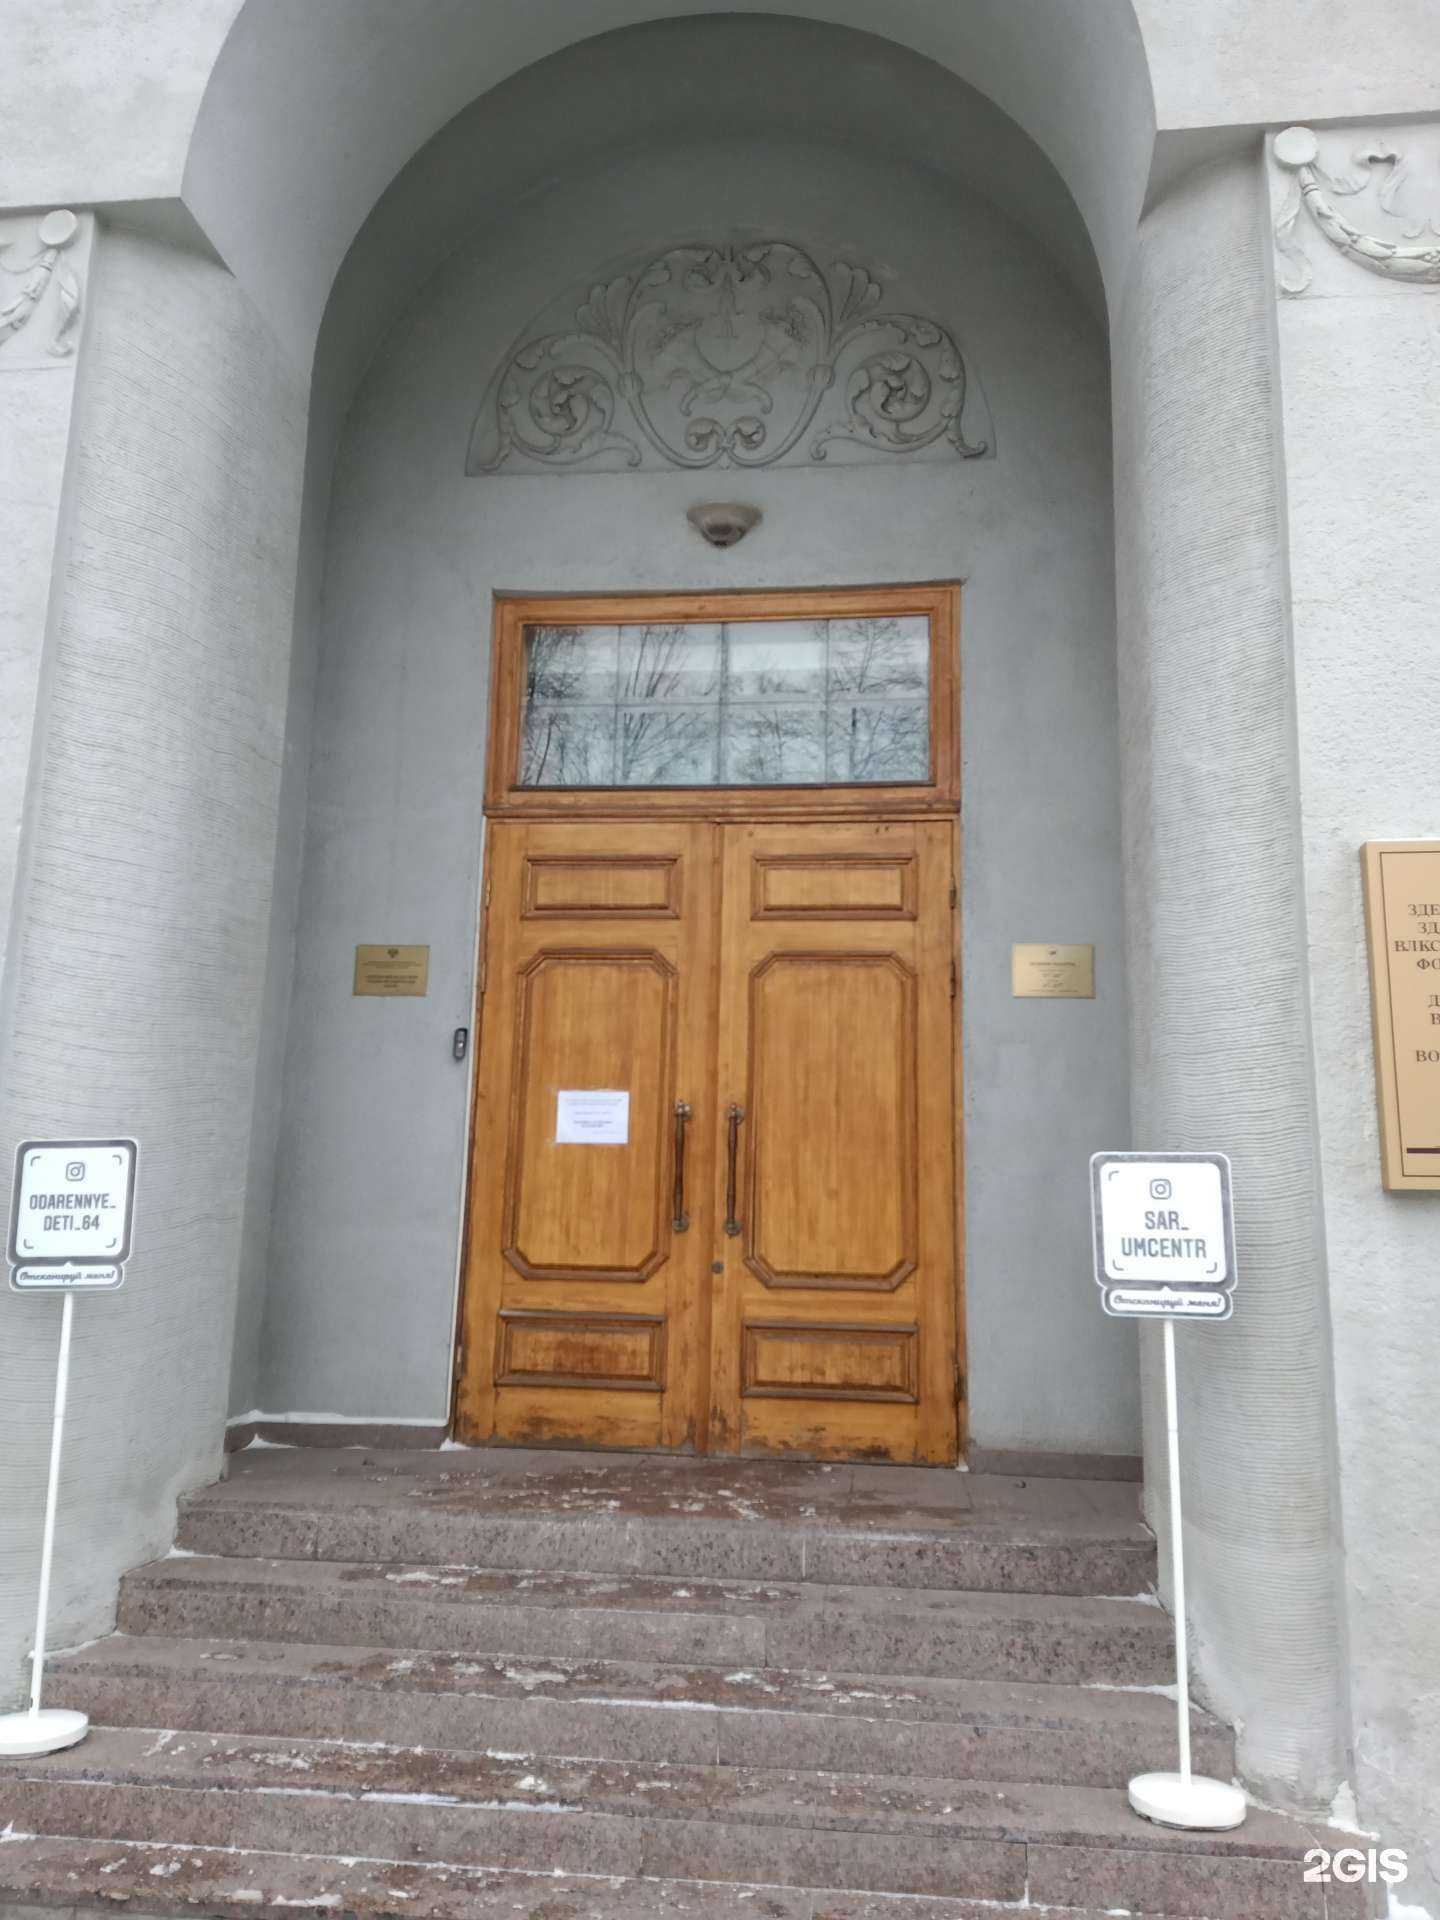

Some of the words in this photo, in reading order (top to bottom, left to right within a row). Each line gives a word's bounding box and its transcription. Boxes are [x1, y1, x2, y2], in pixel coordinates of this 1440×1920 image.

[29, 1193, 117, 1210] ODARENNYE_
[43, 1214, 100, 1231] DETI_64
[1144, 1210, 1190, 1231] SAR_
[1121, 1236, 1207, 1259] UMCENTR
